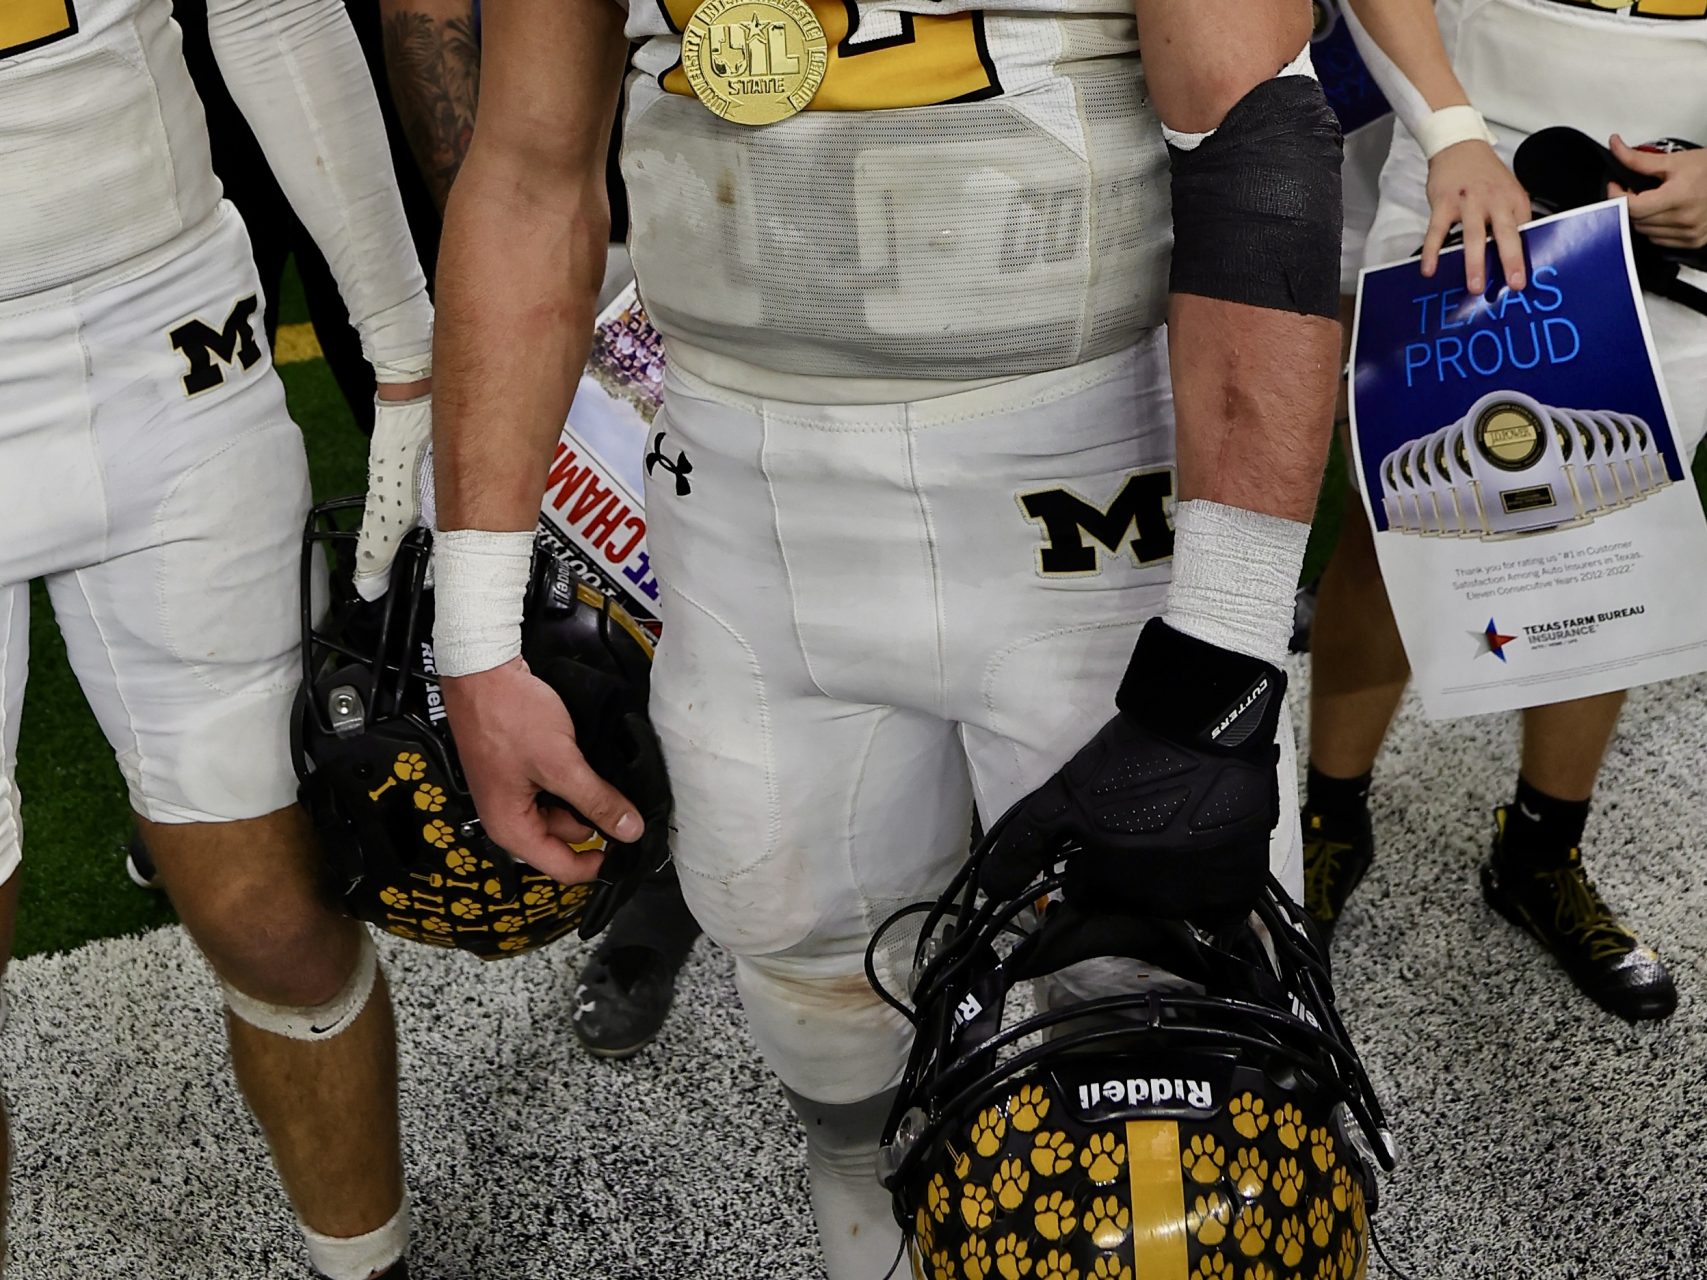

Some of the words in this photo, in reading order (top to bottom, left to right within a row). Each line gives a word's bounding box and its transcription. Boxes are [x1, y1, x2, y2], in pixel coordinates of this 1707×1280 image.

[728, 77, 785, 95] STATE
[1412, 265, 1563, 335] TEXAS
[166, 291, 264, 400] M
[1405, 317, 1580, 387] PROUD
[1013, 464, 1178, 579] M
[1484, 564, 1501, 574] you
[1502, 561, 1515, 569] for
[1586, 541, 1632, 556] Customer
[1507, 570, 1541, 581] Among
[1541, 566, 1564, 576] Auto
[1466, 590, 1496, 601] Eleven
[1497, 580, 1553, 596] Consecutive
[1522, 621, 1561, 635] TEXAS
[1562, 615, 1596, 629] FARM
[1597, 605, 1645, 623] BUREAU
[1528, 625, 1597, 644] INSURANCE
[1211, 678, 1268, 740] CUTTERS
[1078, 1077, 1213, 1110] Riddell
